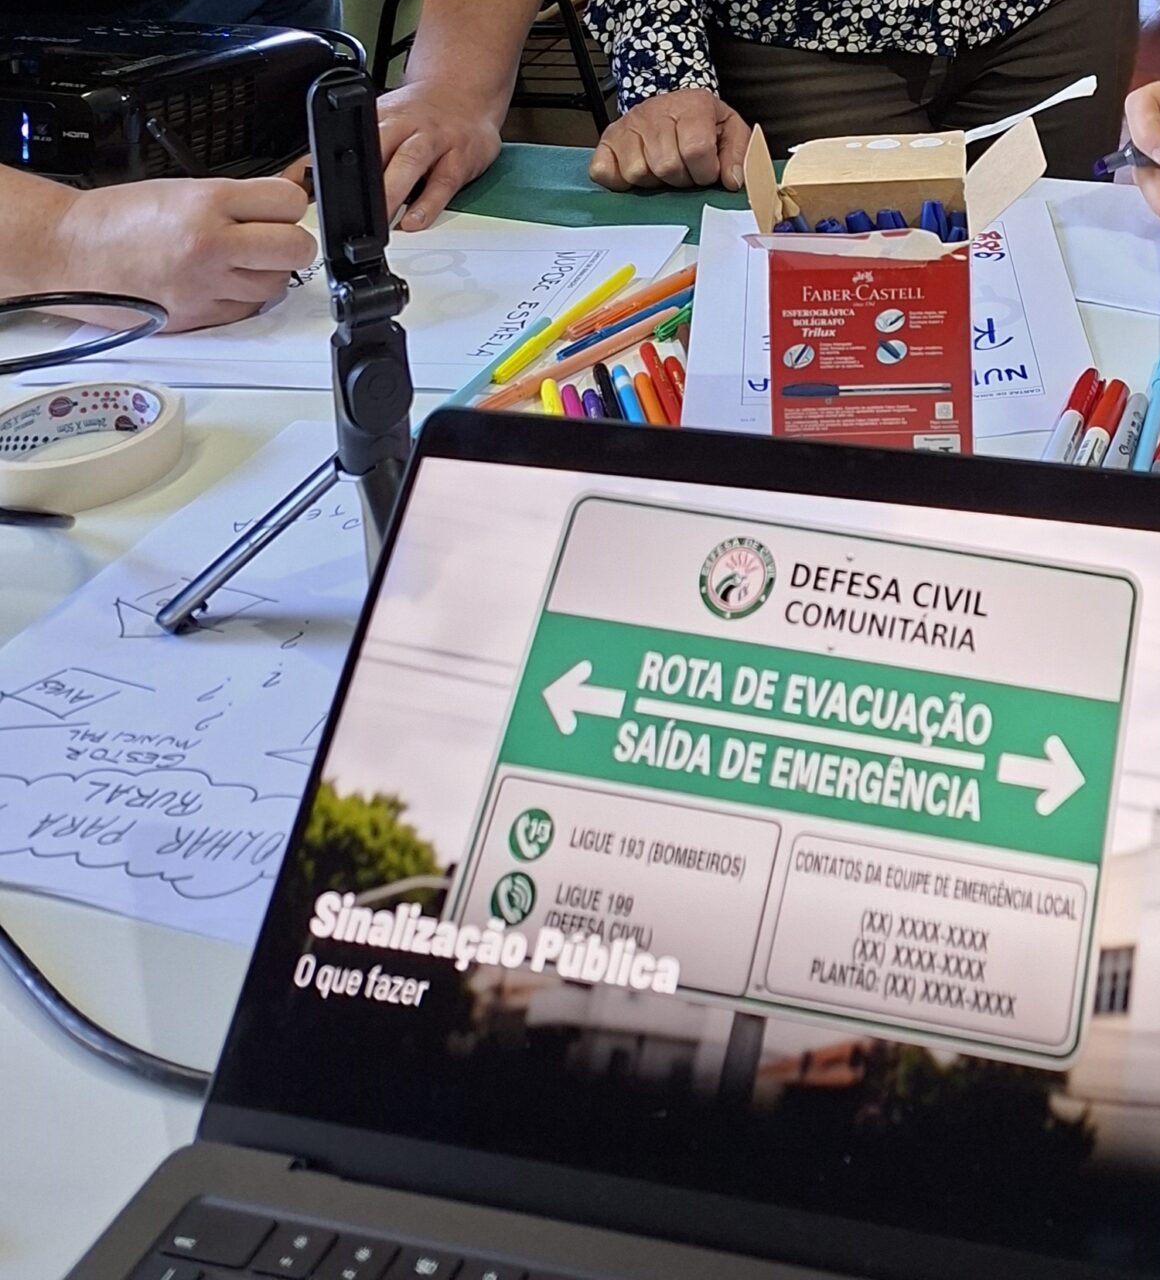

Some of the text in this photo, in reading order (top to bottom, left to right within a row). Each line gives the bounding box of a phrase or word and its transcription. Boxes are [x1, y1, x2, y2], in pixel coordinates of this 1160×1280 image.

[63, 130, 89, 139] HDMI
[782, 307, 856, 318] ESFEROGRÁFICA
[802, 284, 925, 303] FABER-CASTELL
[467, 300, 540, 358] ESTRELA
[793, 317, 845, 327] BOLÍGRAFO
[802, 327, 837, 338] Trilux
[790, 563, 989, 617] DEFESA CIVIL
[784, 600, 976, 652] COMUNITÁRIA
[36, 679, 97, 705] AVES
[637, 650, 994, 748] ROTA DE EVACUAÇÃO
[65, 746, 187, 768] GESTOR
[613, 718, 983, 822] SAÍDA DE EMERGÊNCIA
[85, 780, 203, 817] RURAL
[28, 813, 286, 865] OLHAR PARA
[569, 826, 747, 883] LIGUE 193 (BOMBEIROS)
[556, 881, 635, 918] LIGUE 199
[795, 850, 1078, 921] CONTATOS DA EQUIPE DE EMERGÊNCIA LOCAL
[309, 891, 681, 995] Sinalização Pública
[861, 908, 990, 953] (XX) XXXX-XXXX
[293, 953, 431, 1010] O que fazer
[853, 937, 987, 983] (XX) XXXX-XXXX
[810, 958, 1017, 1019] PLANTÃO: (XX) XXXX-XXXX
